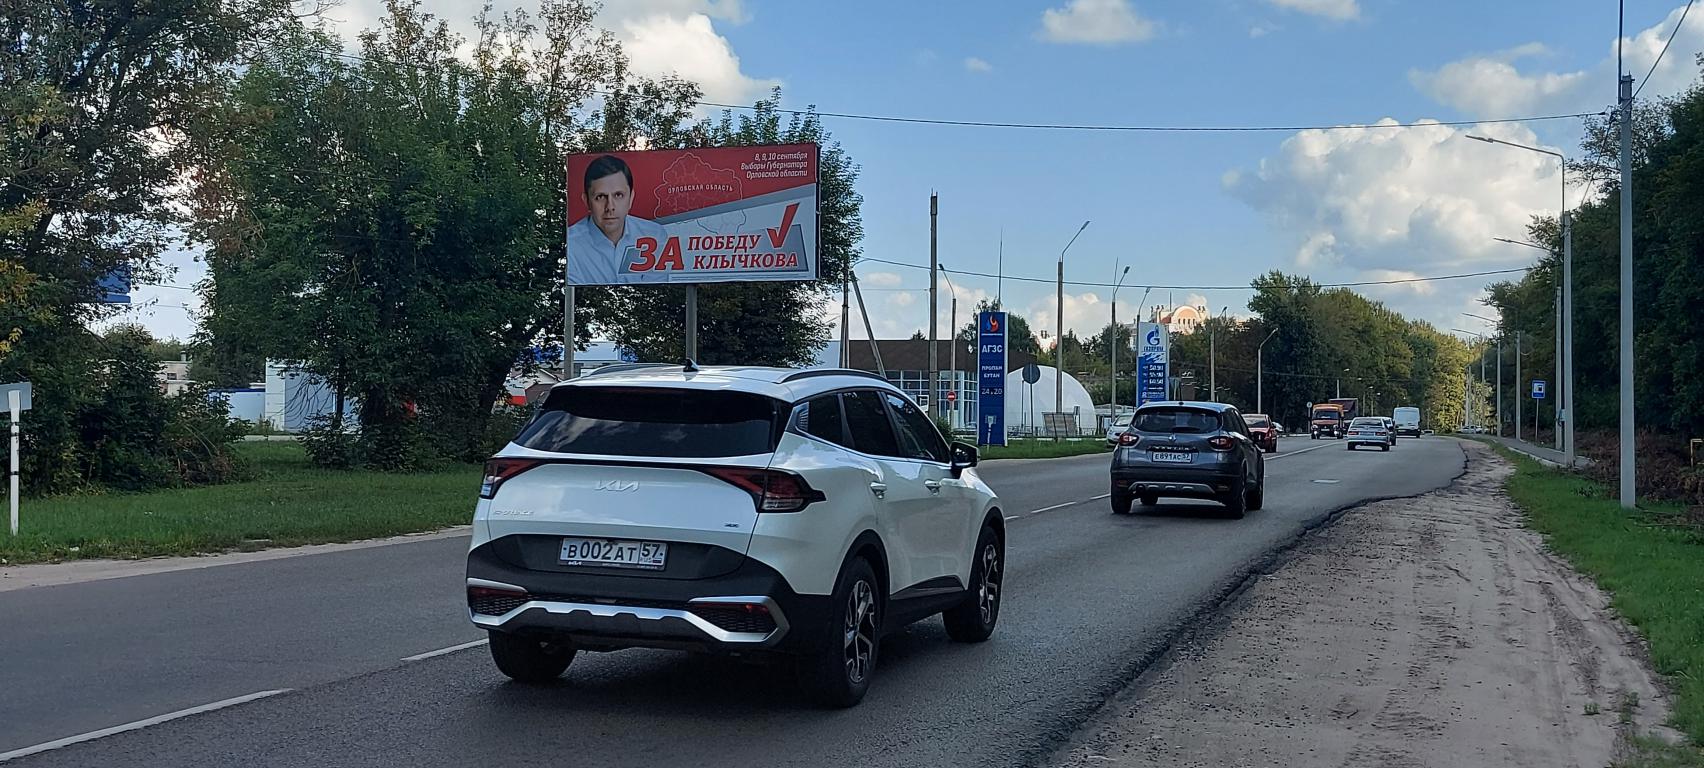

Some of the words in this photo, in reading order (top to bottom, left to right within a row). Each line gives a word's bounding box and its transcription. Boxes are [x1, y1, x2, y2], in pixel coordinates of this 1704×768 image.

[754, 153, 761, 161] 8,
[761, 153, 768, 161] 9,
[768, 152, 777, 160] 10
[776, 151, 808, 160] сентября
[740, 162, 766, 171] Выборы
[766, 161, 808, 170] Губернатора
[746, 171, 780, 180] Орловской
[780, 169, 808, 177] области
[667, 183, 704, 194] ОРЛОВСКАЯ
[687, 234, 761, 253] ПОБЕДУ
[630, 236, 684, 272] ЗА
[693, 252, 799, 270] КЛЫЧКОВА
[981, 344, 1003, 353] АГЗС
[641, 543, 661, 558] 57
